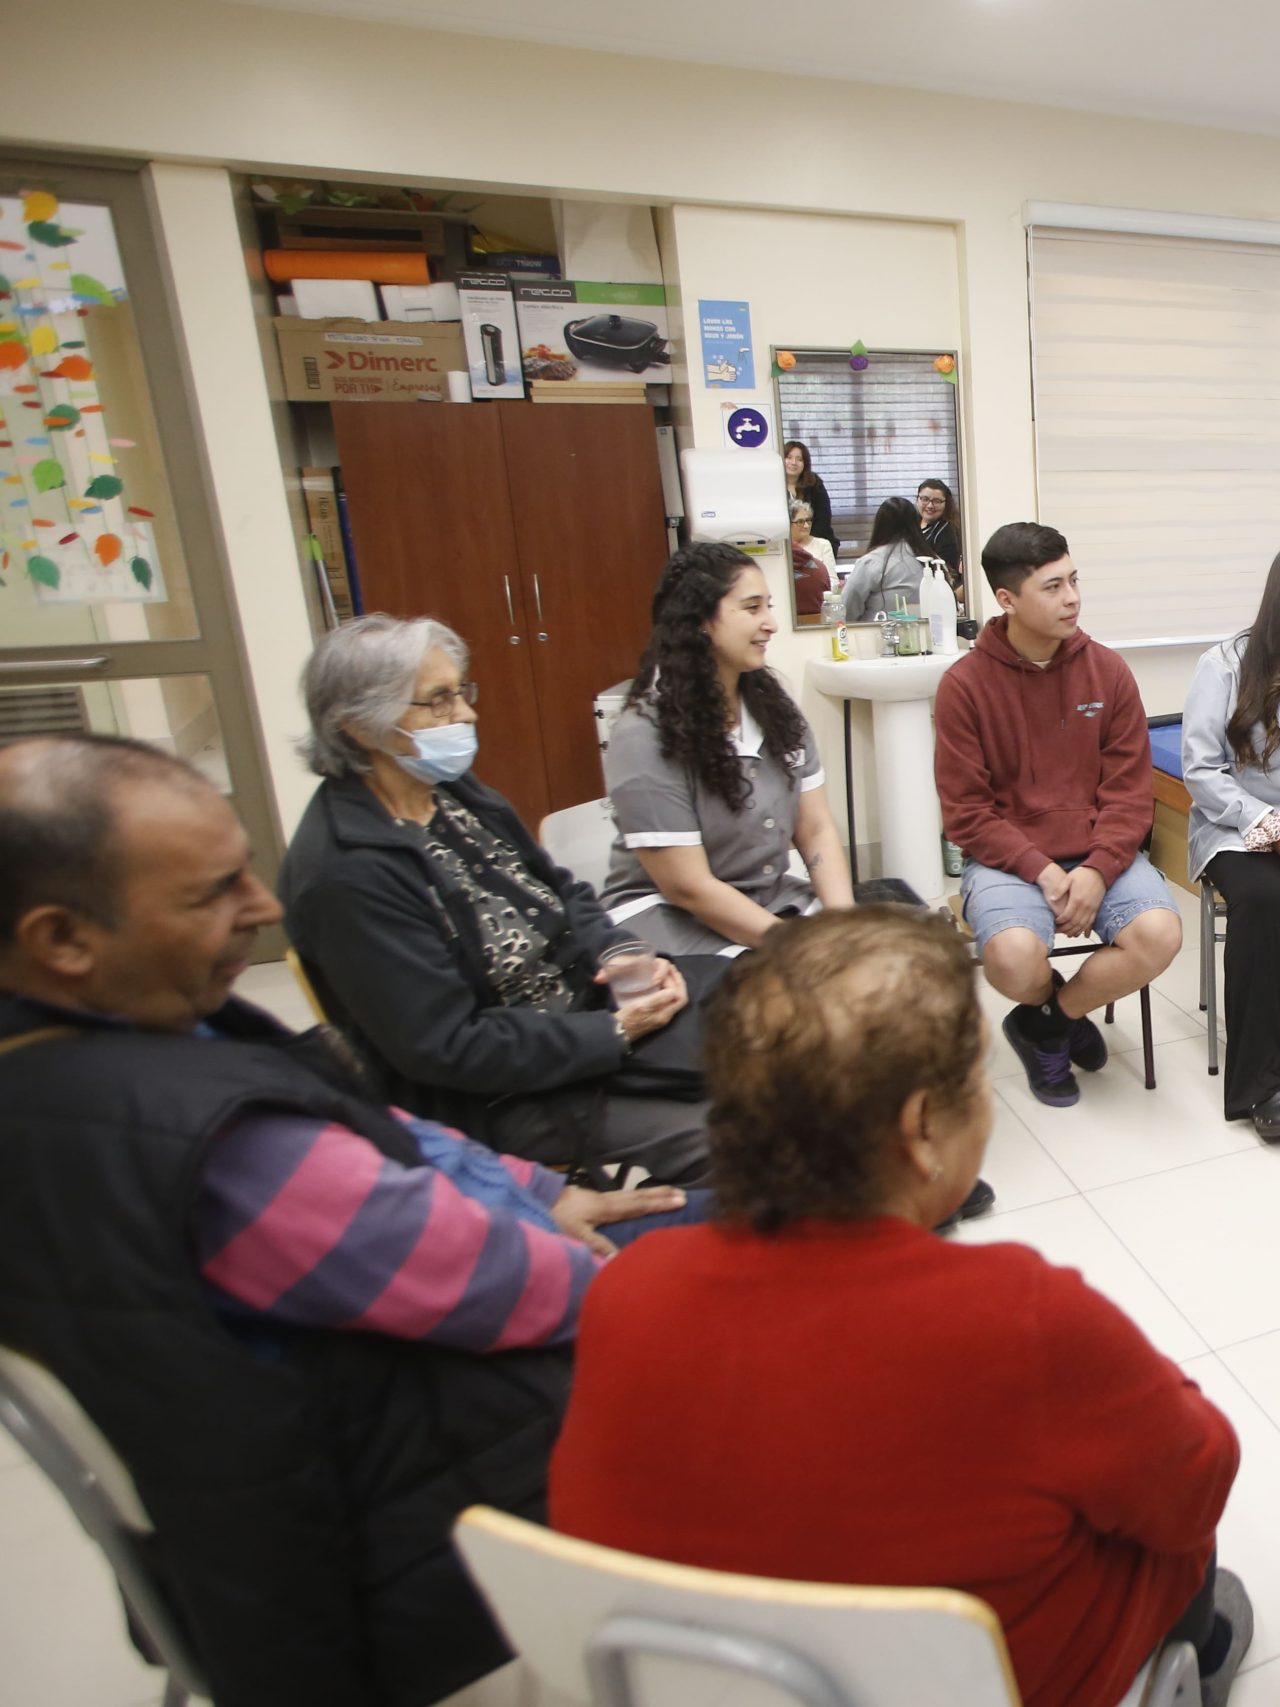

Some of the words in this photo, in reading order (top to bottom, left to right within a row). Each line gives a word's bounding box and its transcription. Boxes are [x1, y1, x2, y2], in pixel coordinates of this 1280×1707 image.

[520, 287, 572, 297] recco
[347, 350, 438, 372] Dimerc
[335, 383, 357, 394] POR
